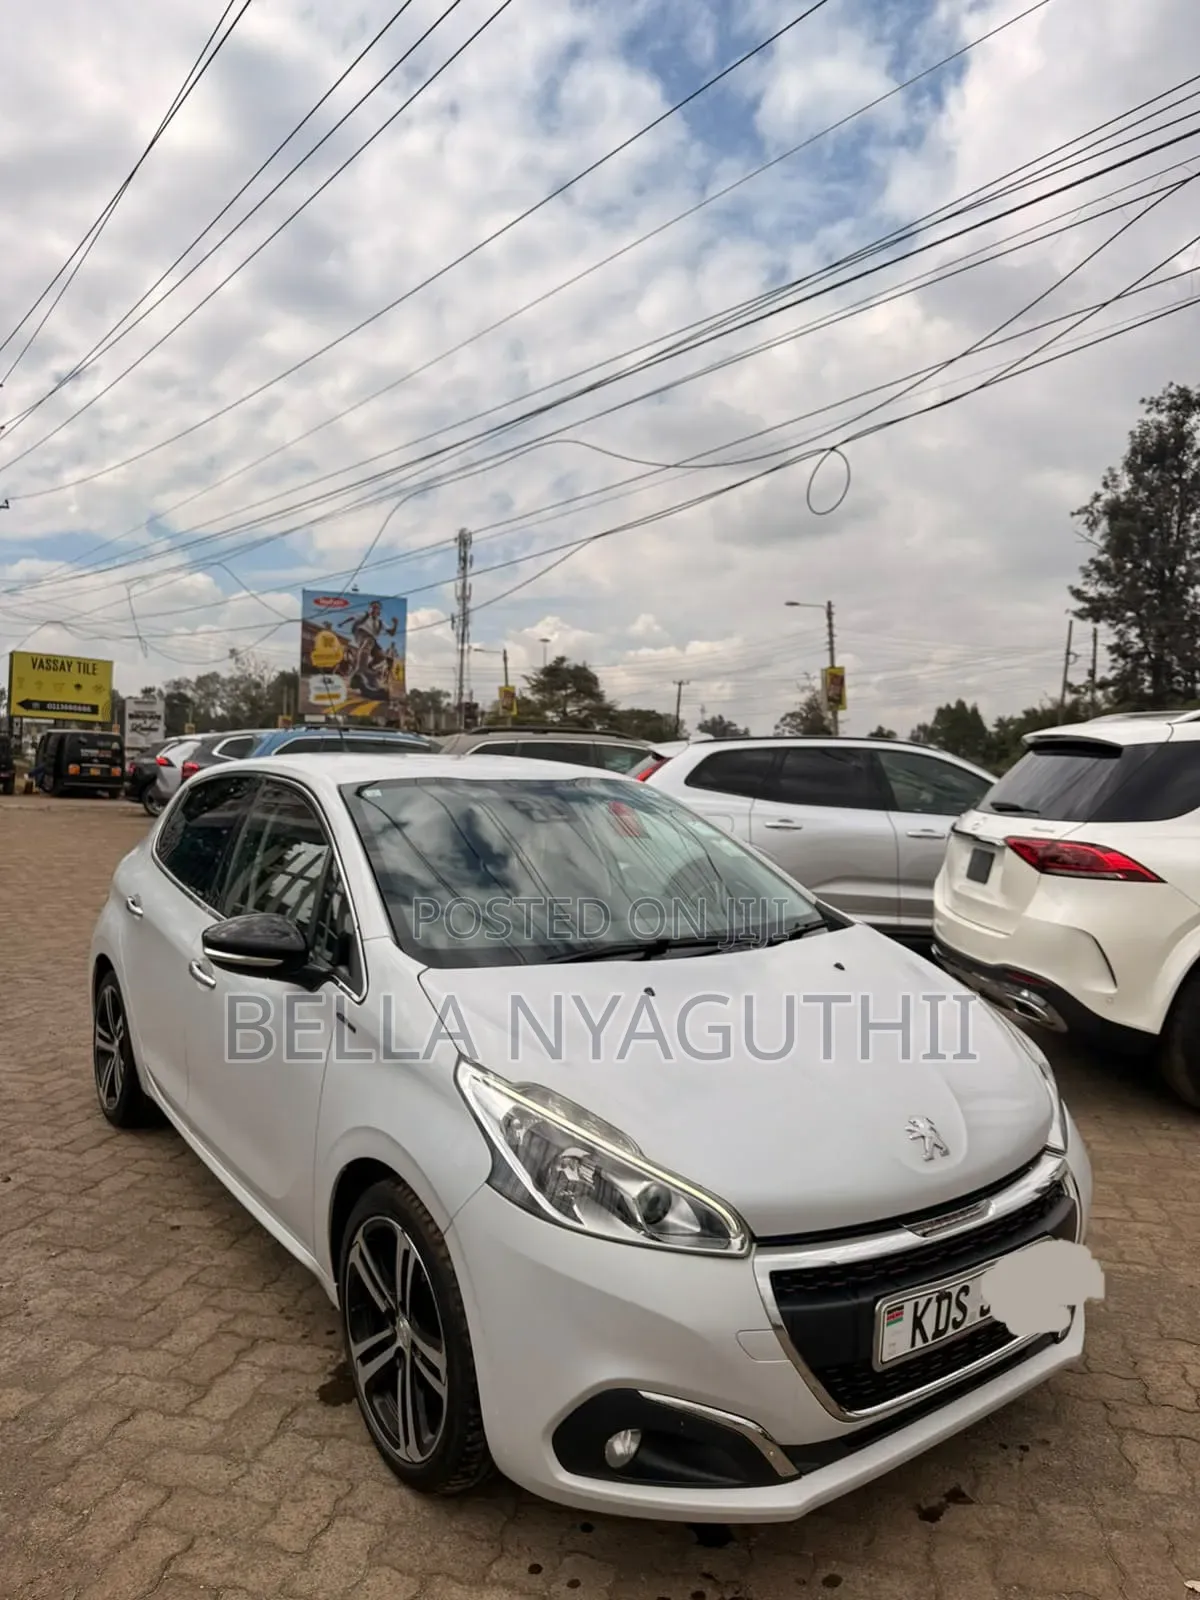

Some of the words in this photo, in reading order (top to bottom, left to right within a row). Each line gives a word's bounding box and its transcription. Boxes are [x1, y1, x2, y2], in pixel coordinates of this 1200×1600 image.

[31, 655, 73, 673] VASSAY
[77, 661, 98, 676] TILE
[910, 1285, 971, 1349] KDS
